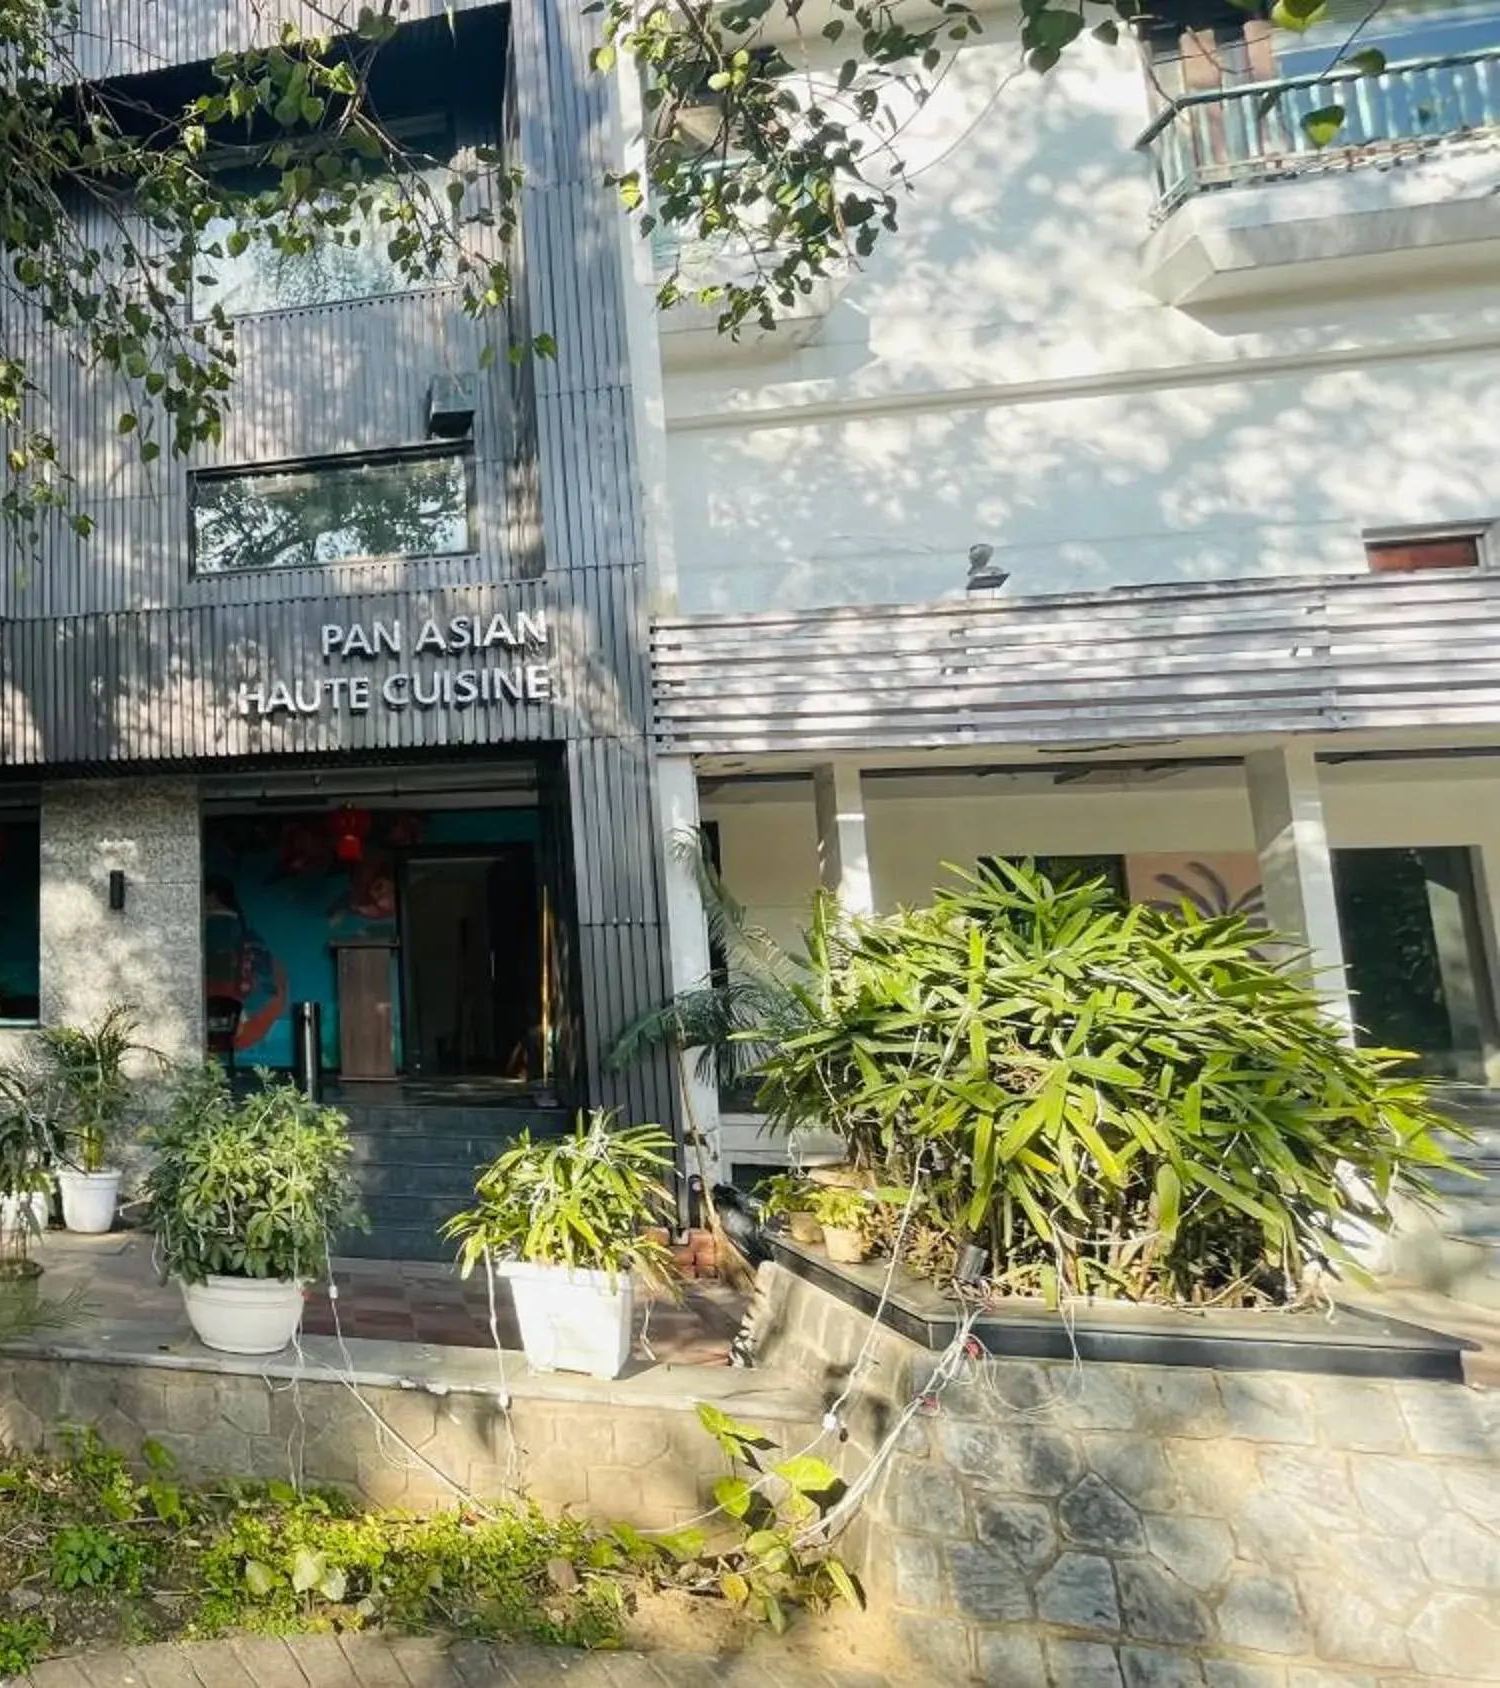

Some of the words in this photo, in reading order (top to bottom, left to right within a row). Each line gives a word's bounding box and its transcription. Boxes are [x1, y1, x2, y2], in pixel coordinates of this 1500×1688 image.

[321, 620, 402, 656] PAN
[415, 609, 549, 652] ASIAN
[238, 676, 371, 714] HAUTE
[382, 666, 552, 706] CUISINE
